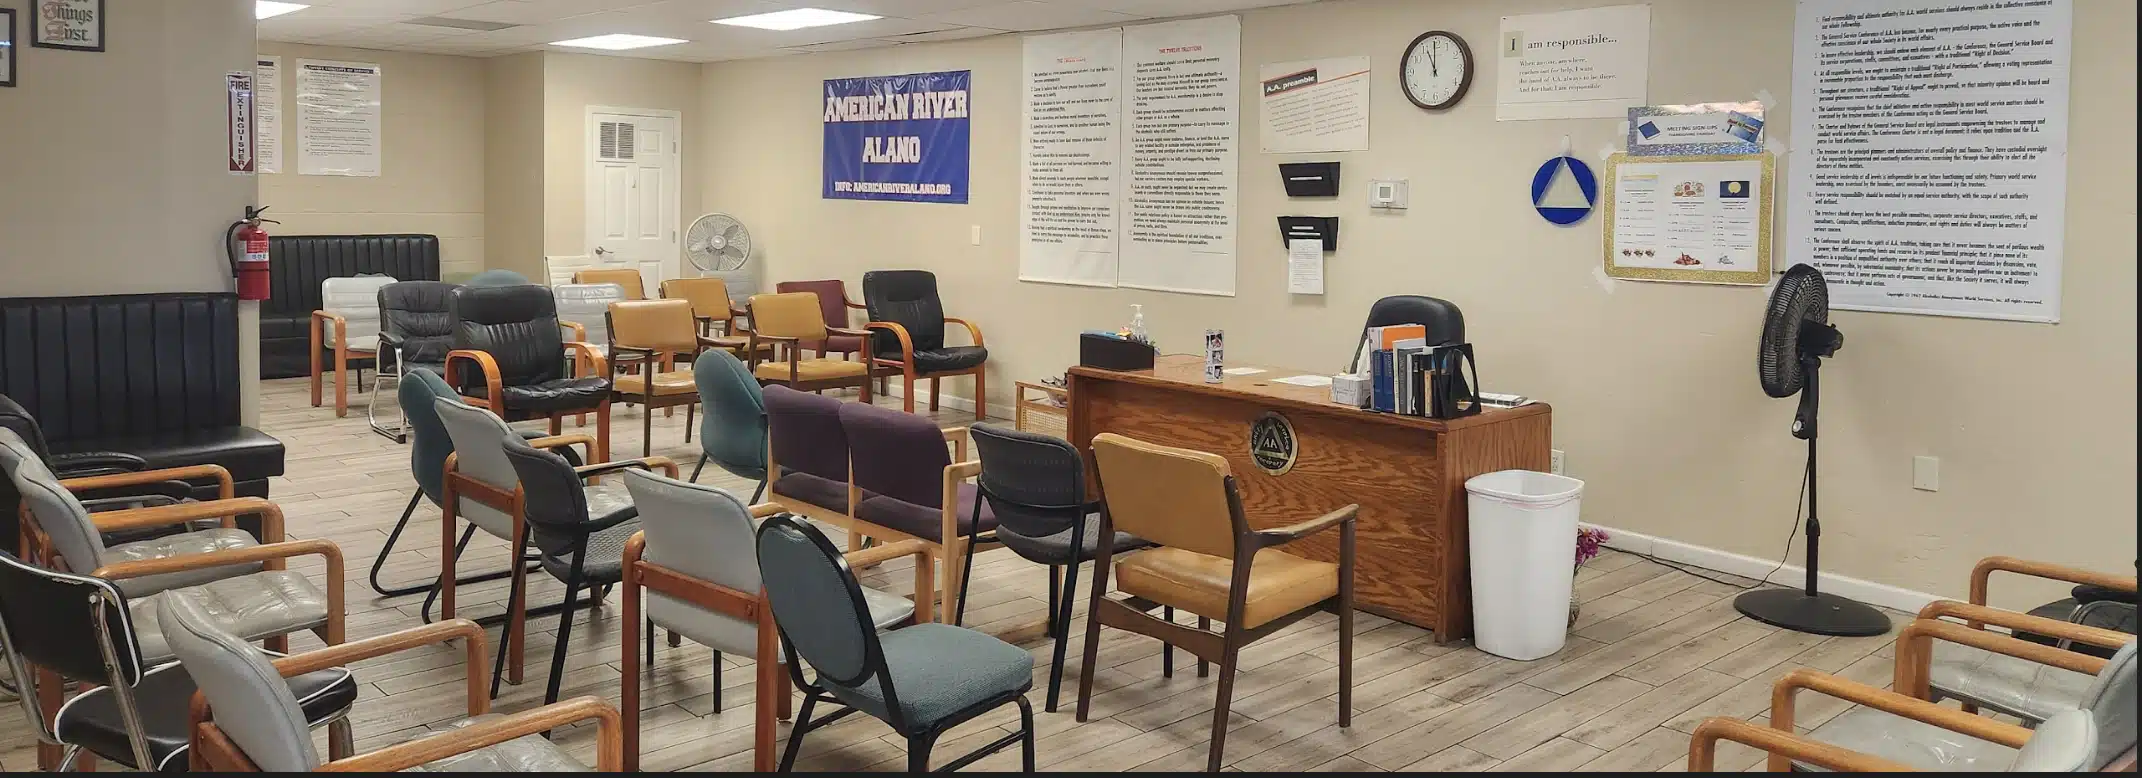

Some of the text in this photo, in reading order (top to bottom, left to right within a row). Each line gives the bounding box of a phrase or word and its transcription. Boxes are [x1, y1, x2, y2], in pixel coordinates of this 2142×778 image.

[42, 2, 93, 25] Things
[1433, 41, 1440, 49] 2
[1445, 43, 1448, 51] 1
[1510, 34, 1617, 51] I am responsible...
[1414, 56, 1421, 64] 10
[1457, 64, 1462, 72] 3
[230, 80, 249, 90] FIRE
[1267, 75, 1314, 93] A.A. preamble
[1433, 92, 1438, 100] 6
[1444, 88, 1449, 96] 5
[824, 91, 967, 122] AMERICAN RIVER
[862, 137, 920, 163] ALANO
[835, 182, 951, 195] INFO: AMERICANRIVERALANO.ORG
[1263, 438, 1278, 449] AA
